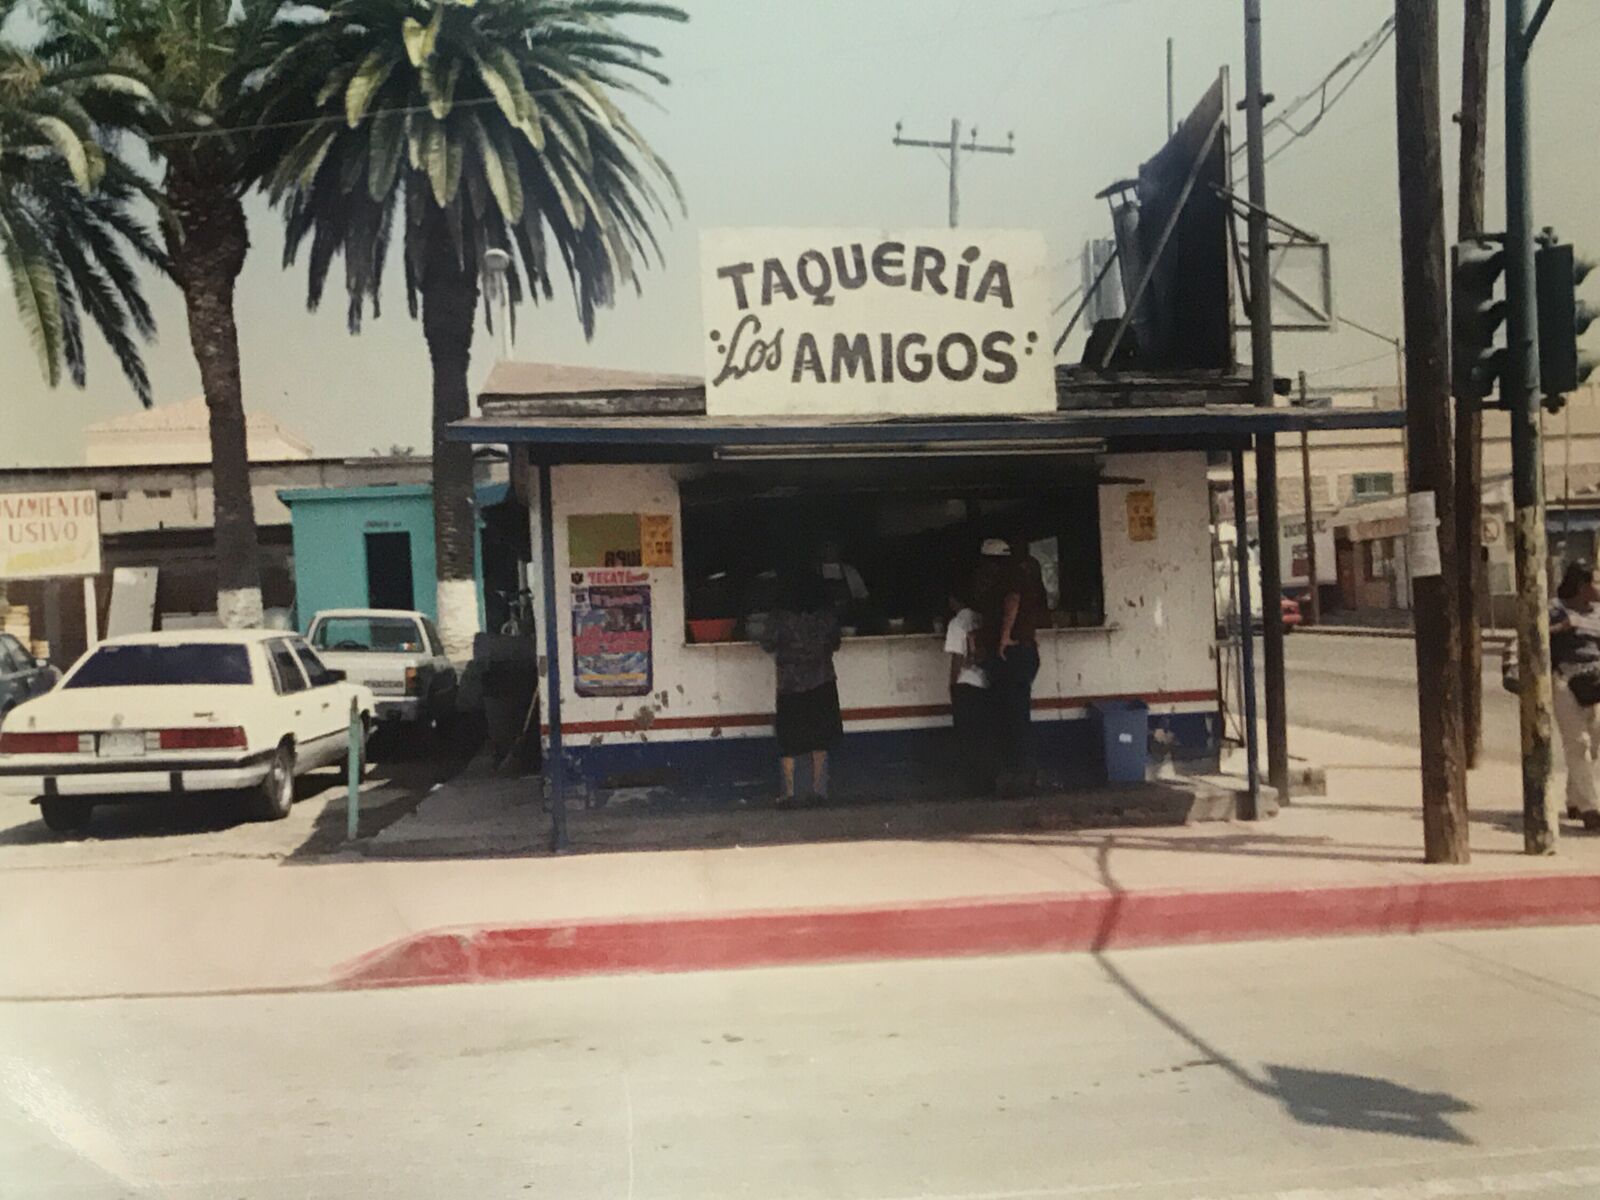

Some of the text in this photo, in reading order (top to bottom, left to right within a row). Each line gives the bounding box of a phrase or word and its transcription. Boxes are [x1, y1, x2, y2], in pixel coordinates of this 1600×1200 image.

[713, 314, 1018, 387] Los AMIGOS
[0, 496, 95, 519] NAMIENTO
